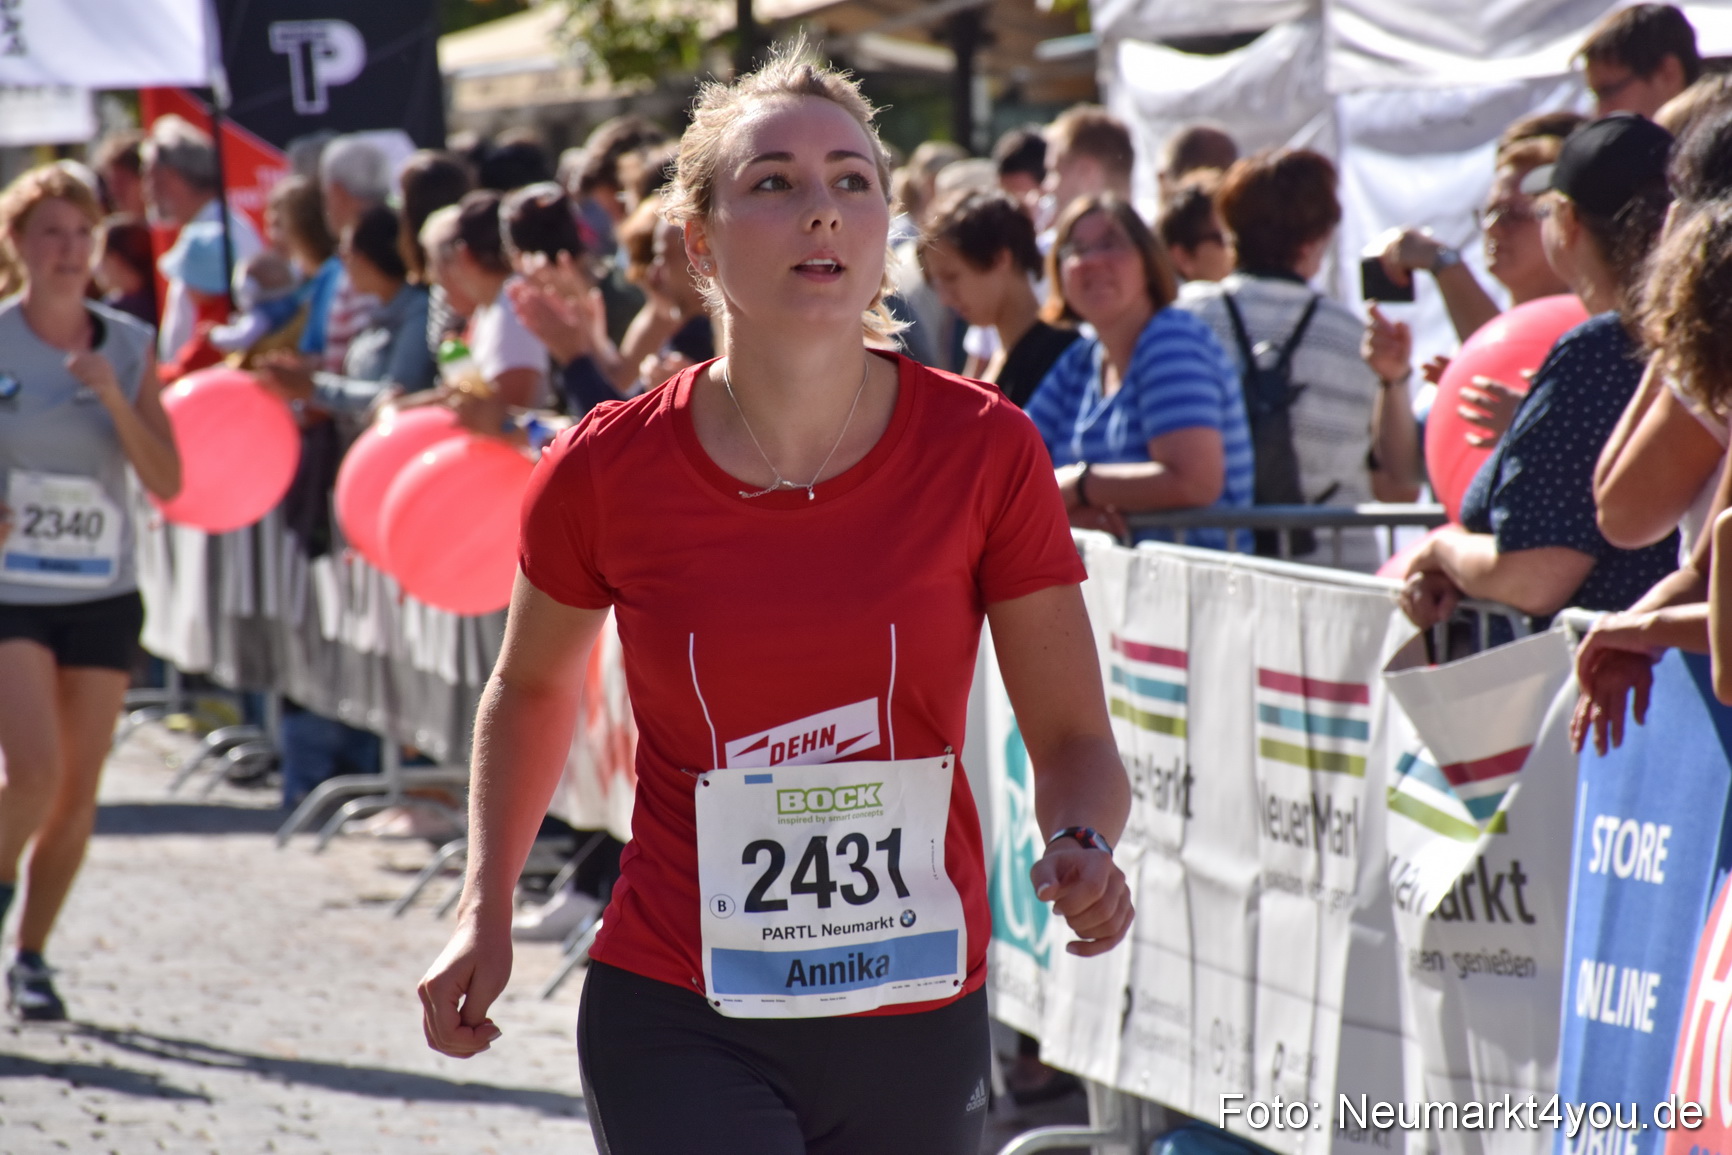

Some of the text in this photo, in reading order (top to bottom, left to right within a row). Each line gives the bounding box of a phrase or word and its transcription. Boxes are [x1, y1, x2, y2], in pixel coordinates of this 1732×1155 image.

[23, 503, 105, 542] 2340
[769, 724, 836, 767] DEHN
[777, 782, 884, 815] BOCK
[778, 808, 884, 826] inspired by smart concepts
[1588, 814, 1672, 885] STORE
[741, 827, 911, 913] 2431
[717, 900, 727, 912] B
[762, 915, 894, 941] PARTL Neumarkt
[785, 952, 891, 988] Annika
[1452, 949, 1536, 980] genießen
[1576, 957, 1661, 1033] ONLINE
